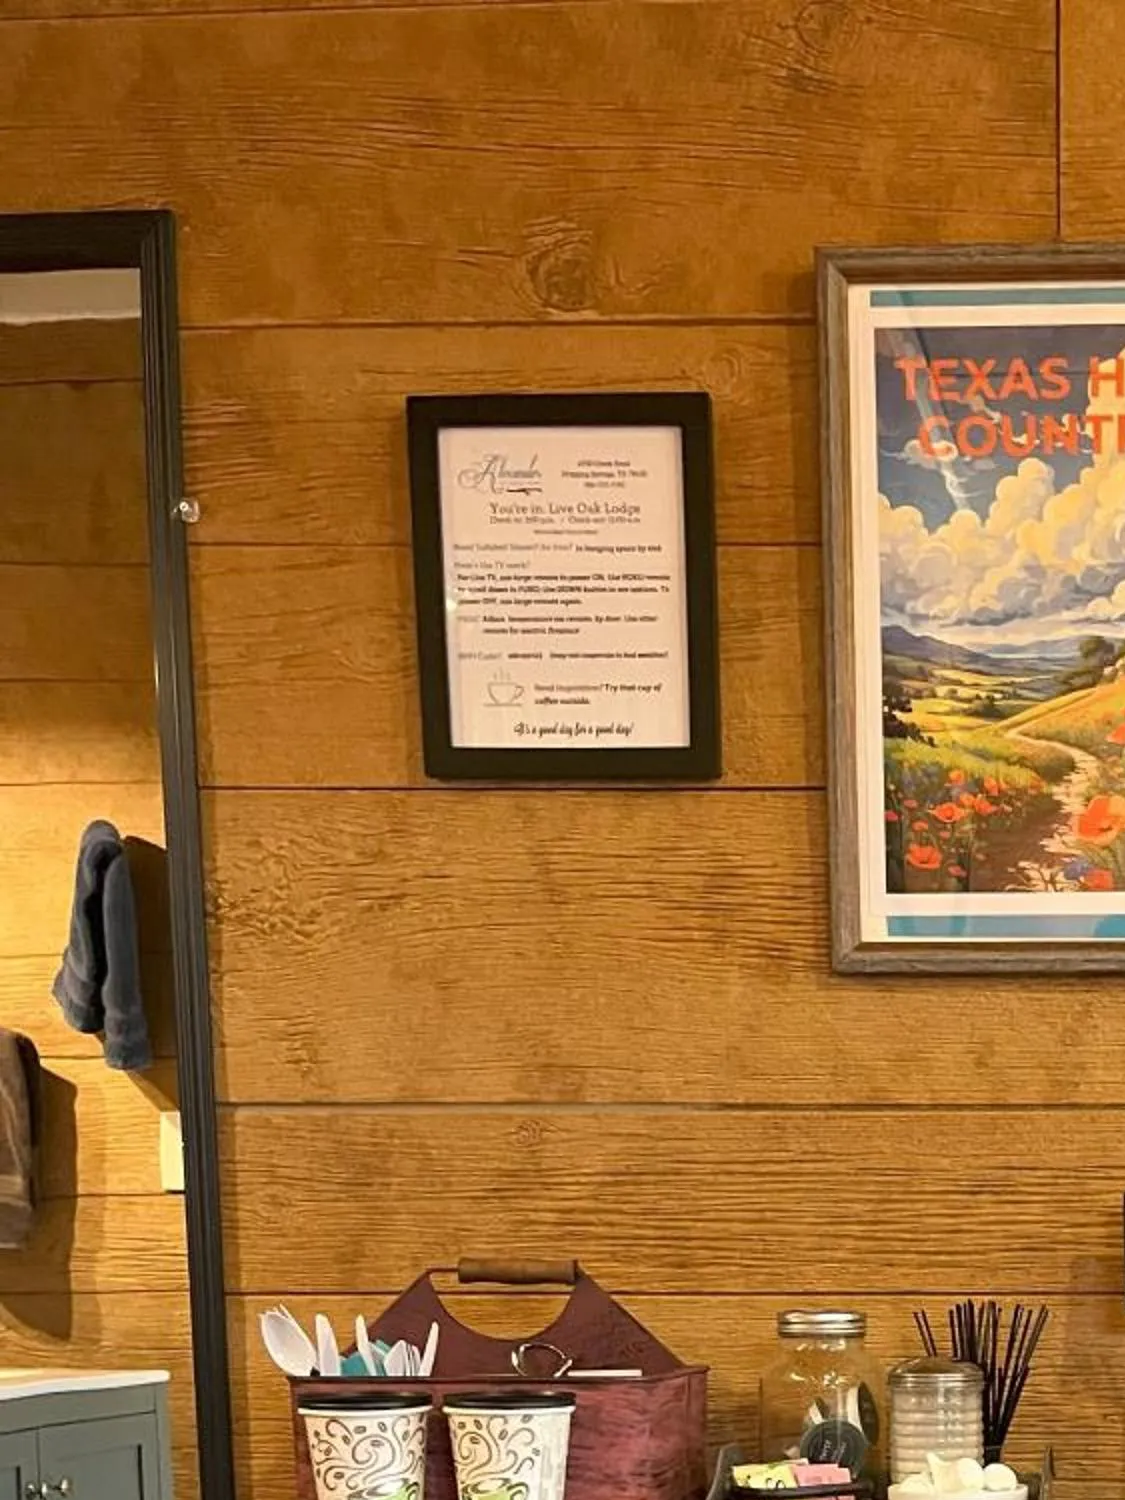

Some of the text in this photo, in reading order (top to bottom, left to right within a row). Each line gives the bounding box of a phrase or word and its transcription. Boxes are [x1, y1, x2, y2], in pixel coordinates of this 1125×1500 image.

[894, 353, 1072, 402] TEXAS
[549, 503, 574, 514] Live
[577, 502, 600, 514] Oak
